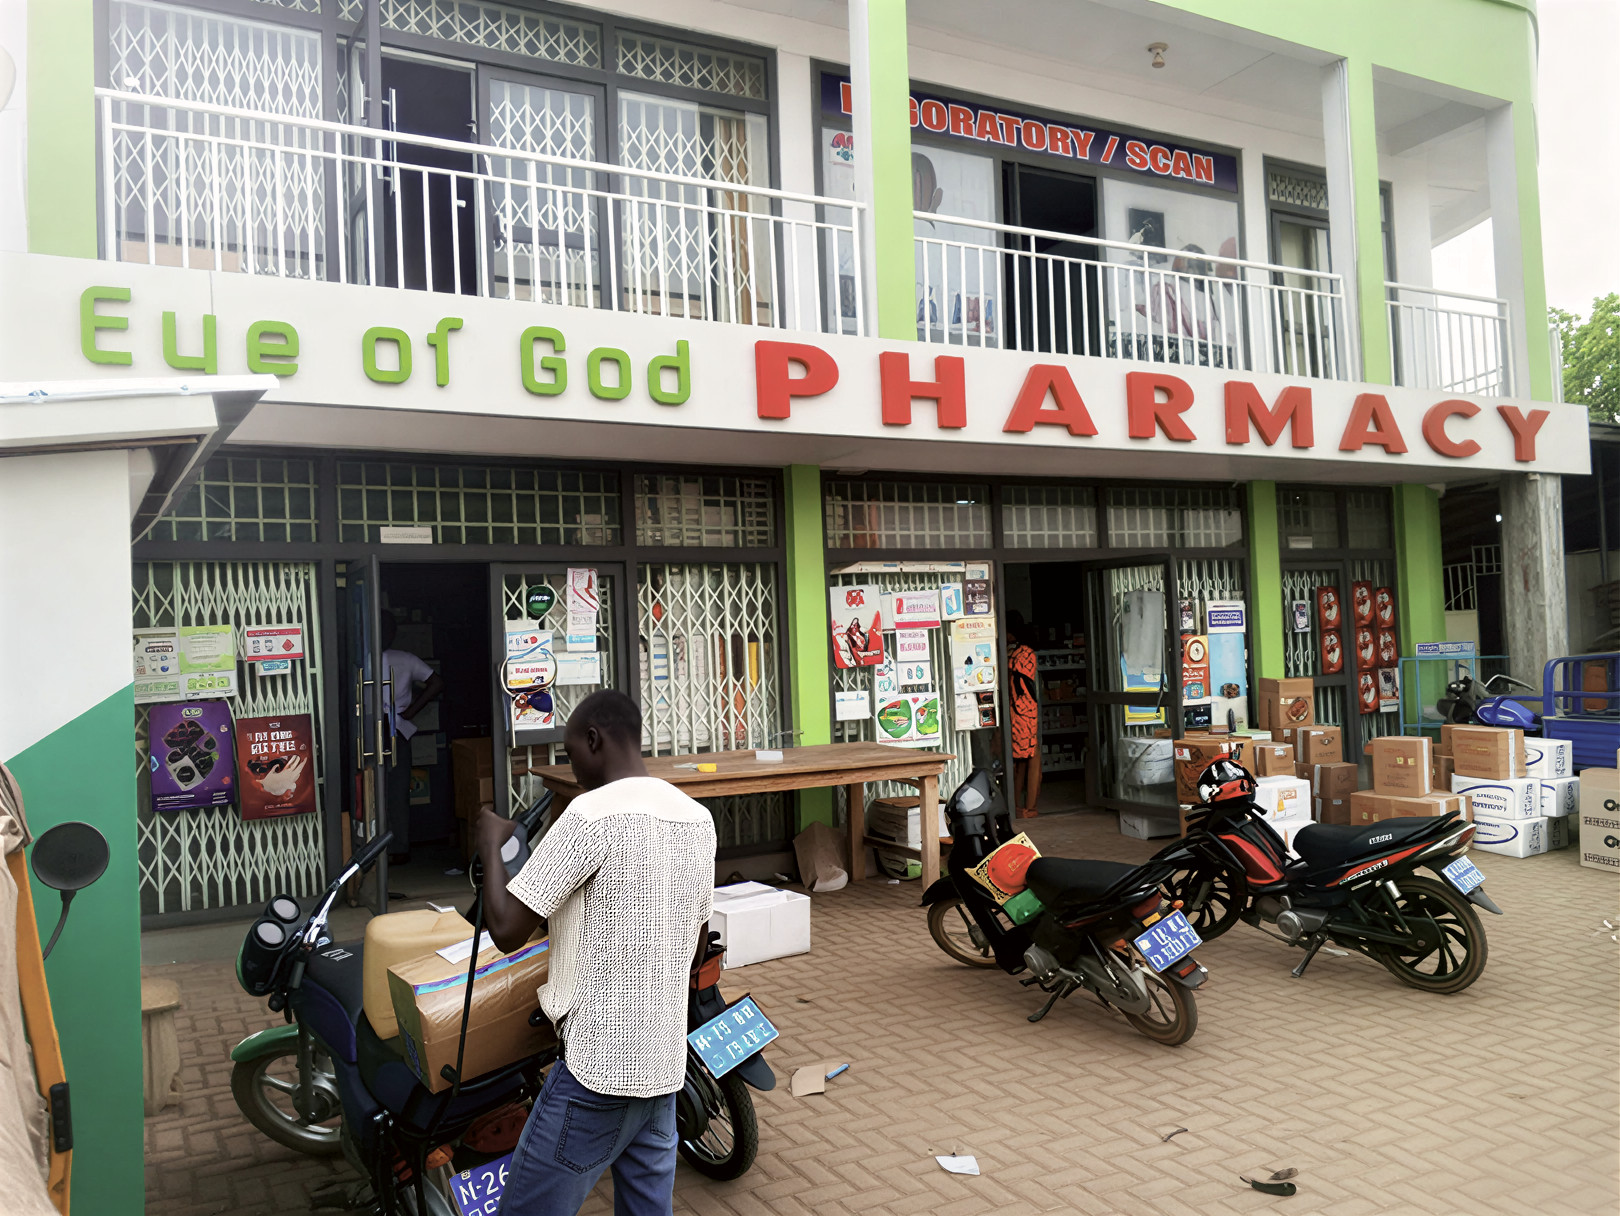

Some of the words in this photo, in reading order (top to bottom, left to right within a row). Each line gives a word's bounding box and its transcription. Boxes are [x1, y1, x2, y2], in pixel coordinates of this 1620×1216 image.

[839, 81, 1094, 161] LORATORY
[1101, 136, 1119, 164] /
[1126, 140, 1214, 185] SCAN
[80, 285, 300, 376] Eye
[362, 315, 464, 388] of
[519, 325, 692, 406] God
[753, 339, 1550, 462] PHARMACY
